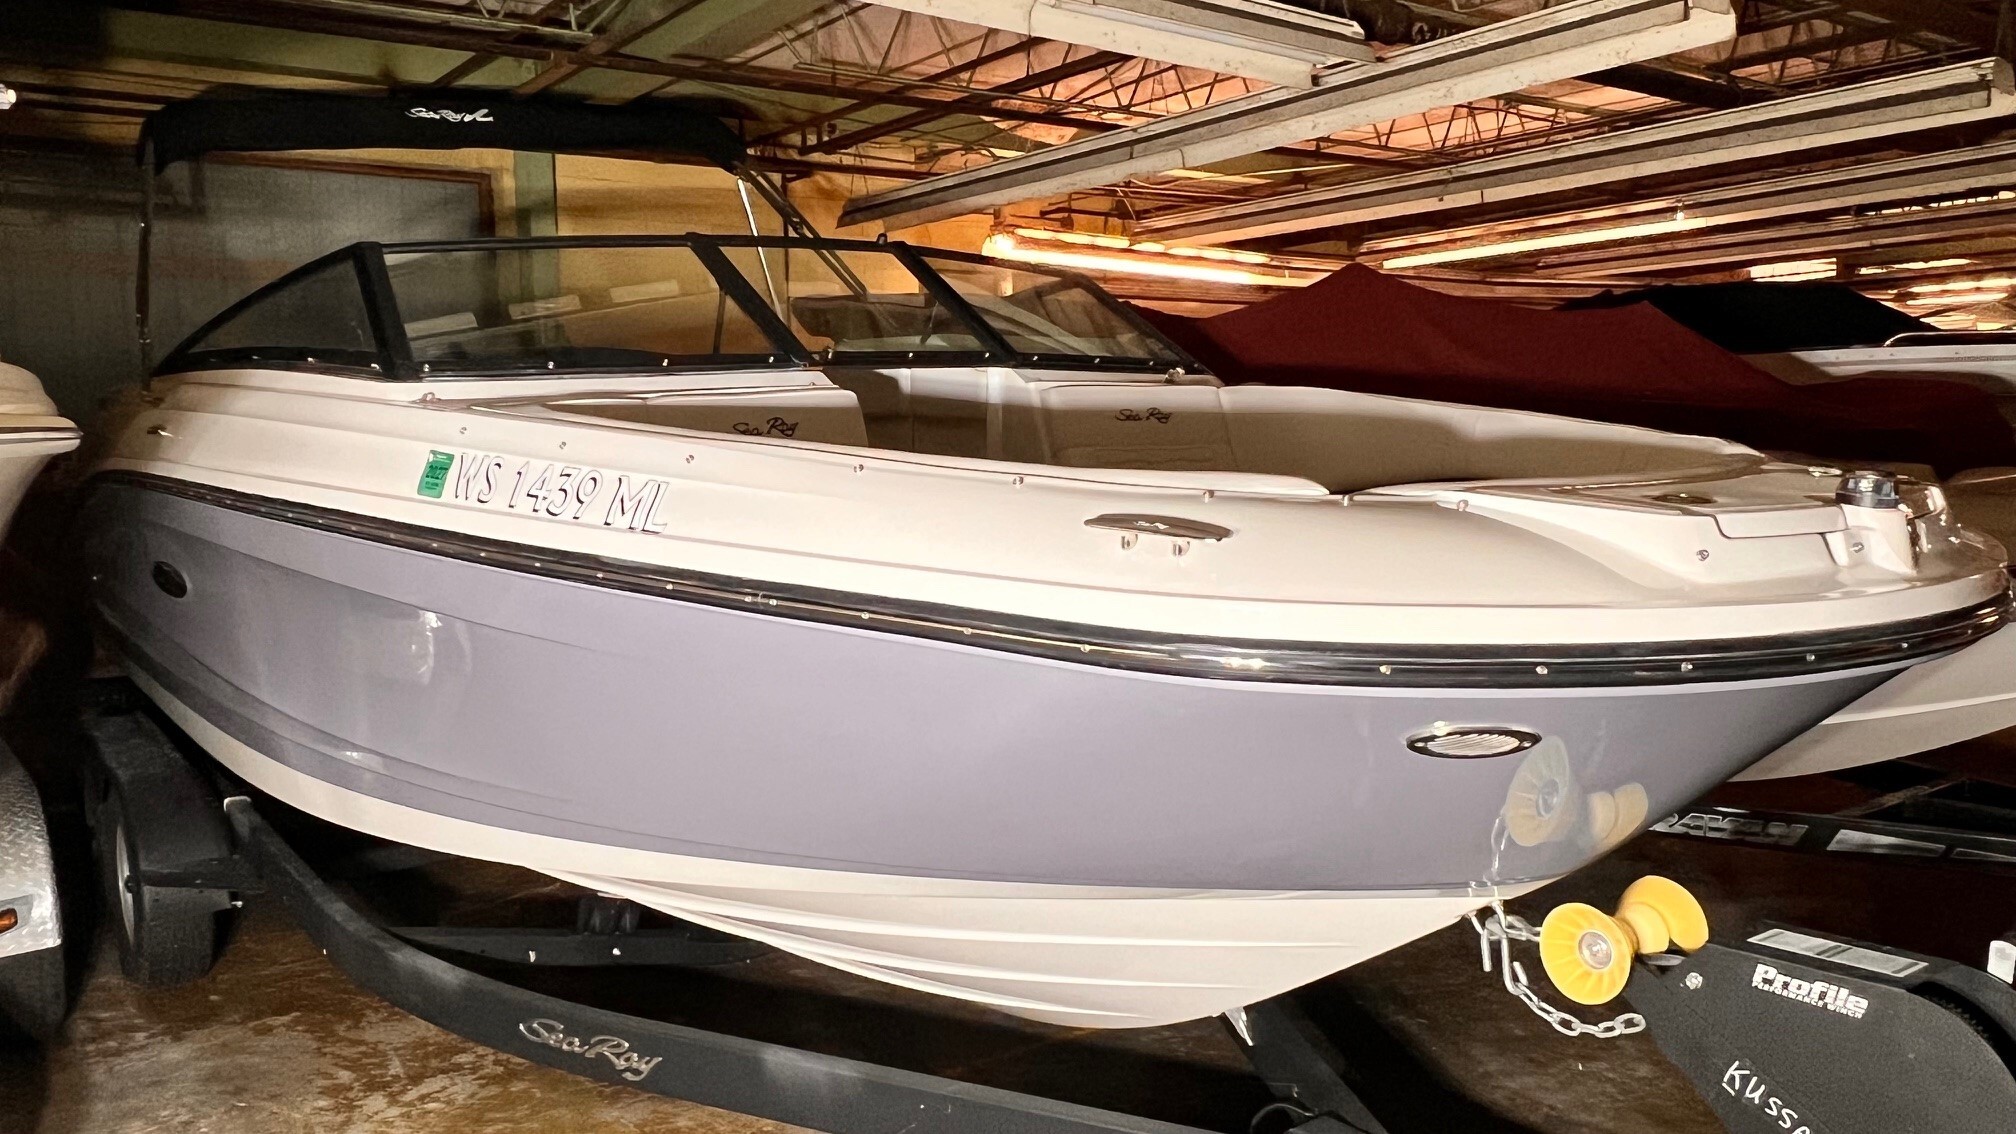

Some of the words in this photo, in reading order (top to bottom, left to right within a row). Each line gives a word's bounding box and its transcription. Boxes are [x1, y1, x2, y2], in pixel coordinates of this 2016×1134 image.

[732, 422, 764, 436] Sea
[766, 416, 799, 437] Ray
[1114, 408, 1143, 421] Sea
[1145, 407, 1172, 424] Ray
[455, 452, 504, 503] WS
[508, 460, 603, 520] 1439
[603, 474, 672, 535] ML
[1751, 980, 1826, 1008] PERFORMANCE
[1826, 1002, 1866, 1019] WINCH
[1752, 963, 1869, 1012] Profile
[519, 1018, 589, 1054] Sea
[584, 1034, 663, 1082] Ray
